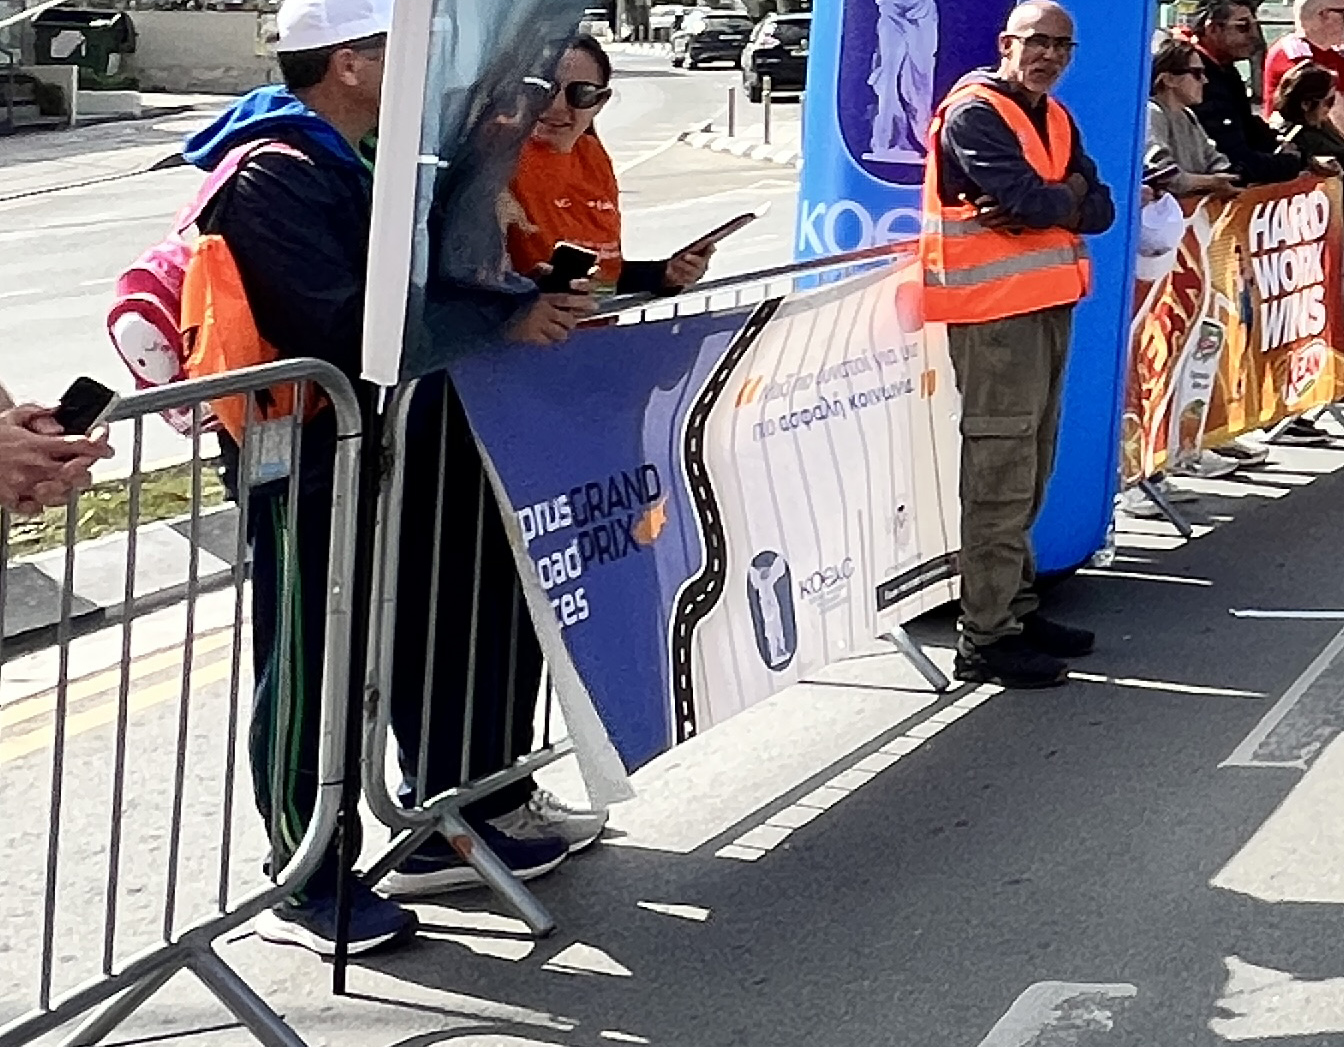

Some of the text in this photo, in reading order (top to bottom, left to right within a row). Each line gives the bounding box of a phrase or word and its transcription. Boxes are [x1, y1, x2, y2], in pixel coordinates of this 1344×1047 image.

[1249, 190, 1330, 253] HARD
[1252, 241, 1325, 300] WORK
[1260, 284, 1326, 352] WINS
[517, 464, 661, 548] prus GRAND
[537, 514, 641, 590] oad PRIX
